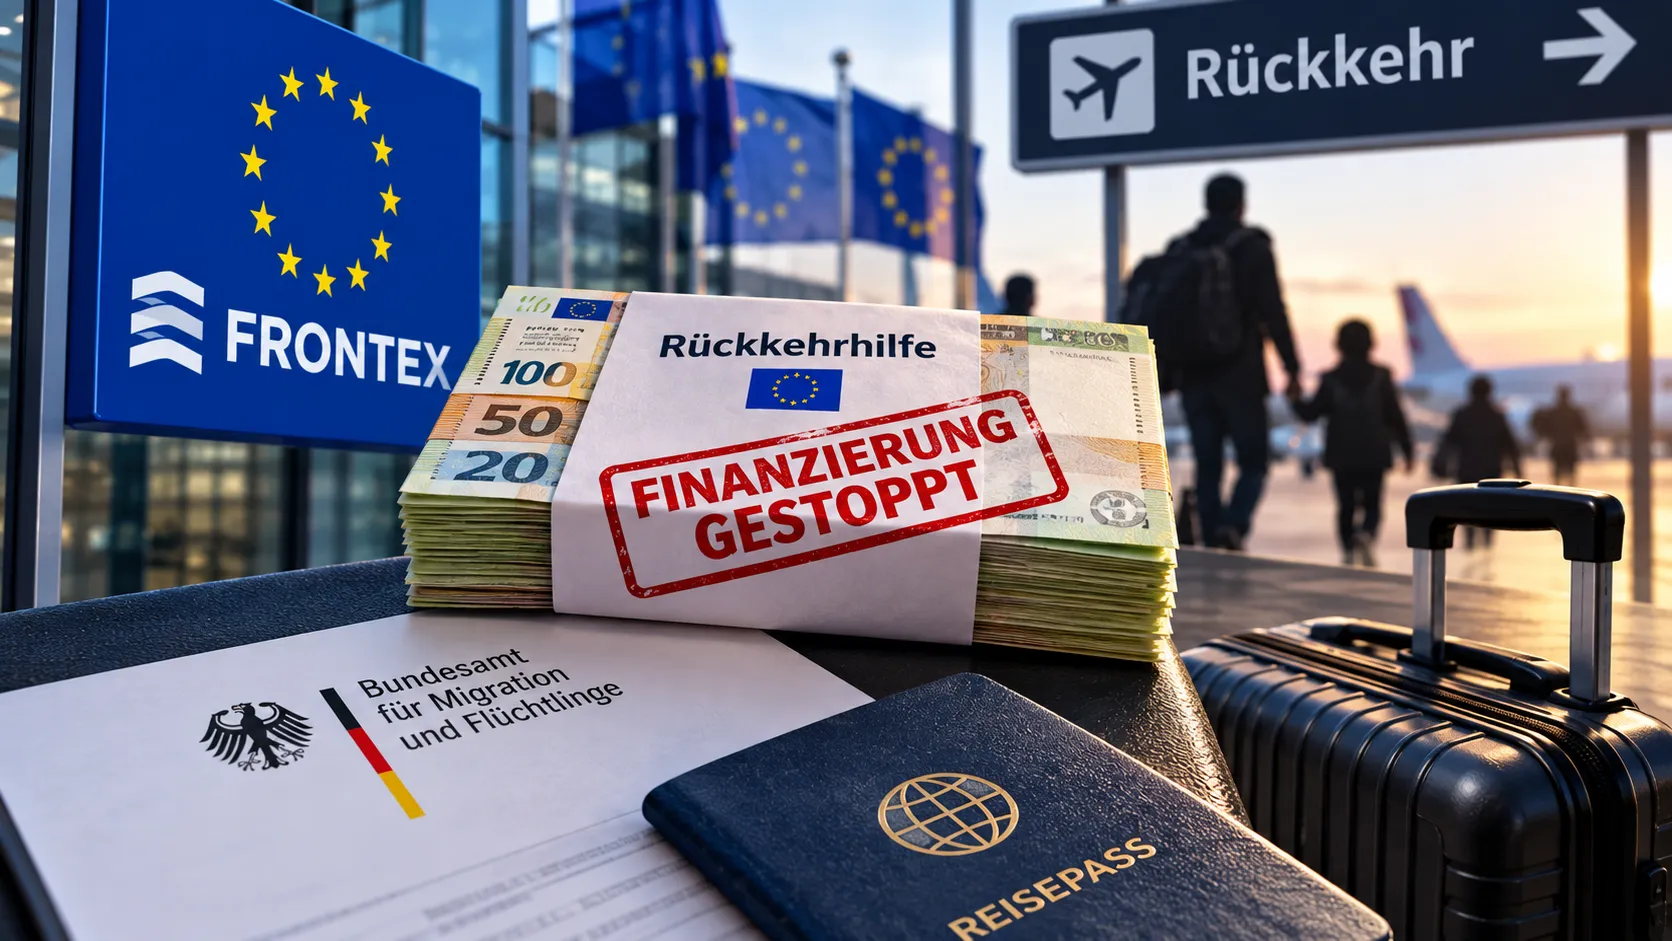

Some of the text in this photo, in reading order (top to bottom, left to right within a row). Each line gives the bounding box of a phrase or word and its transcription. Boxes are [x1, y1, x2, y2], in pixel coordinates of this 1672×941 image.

[1187, 29, 1475, 100] Rückkehr
[226, 308, 453, 391] FRONTEX
[500, 359, 578, 387] 100
[659, 331, 937, 359] Rückkehrhilfe
[474, 403, 564, 438] 50
[453, 450, 549, 484] 20
[630, 409, 1018, 519] FINANZIERUNG
[694, 458, 979, 560] GESTOPPT
[357, 648, 530, 699] Bundesamt
[377, 668, 570, 724] für Migration
[399, 682, 624, 750] und Flüchtlinge
[947, 836, 1158, 941] REISEPASS
